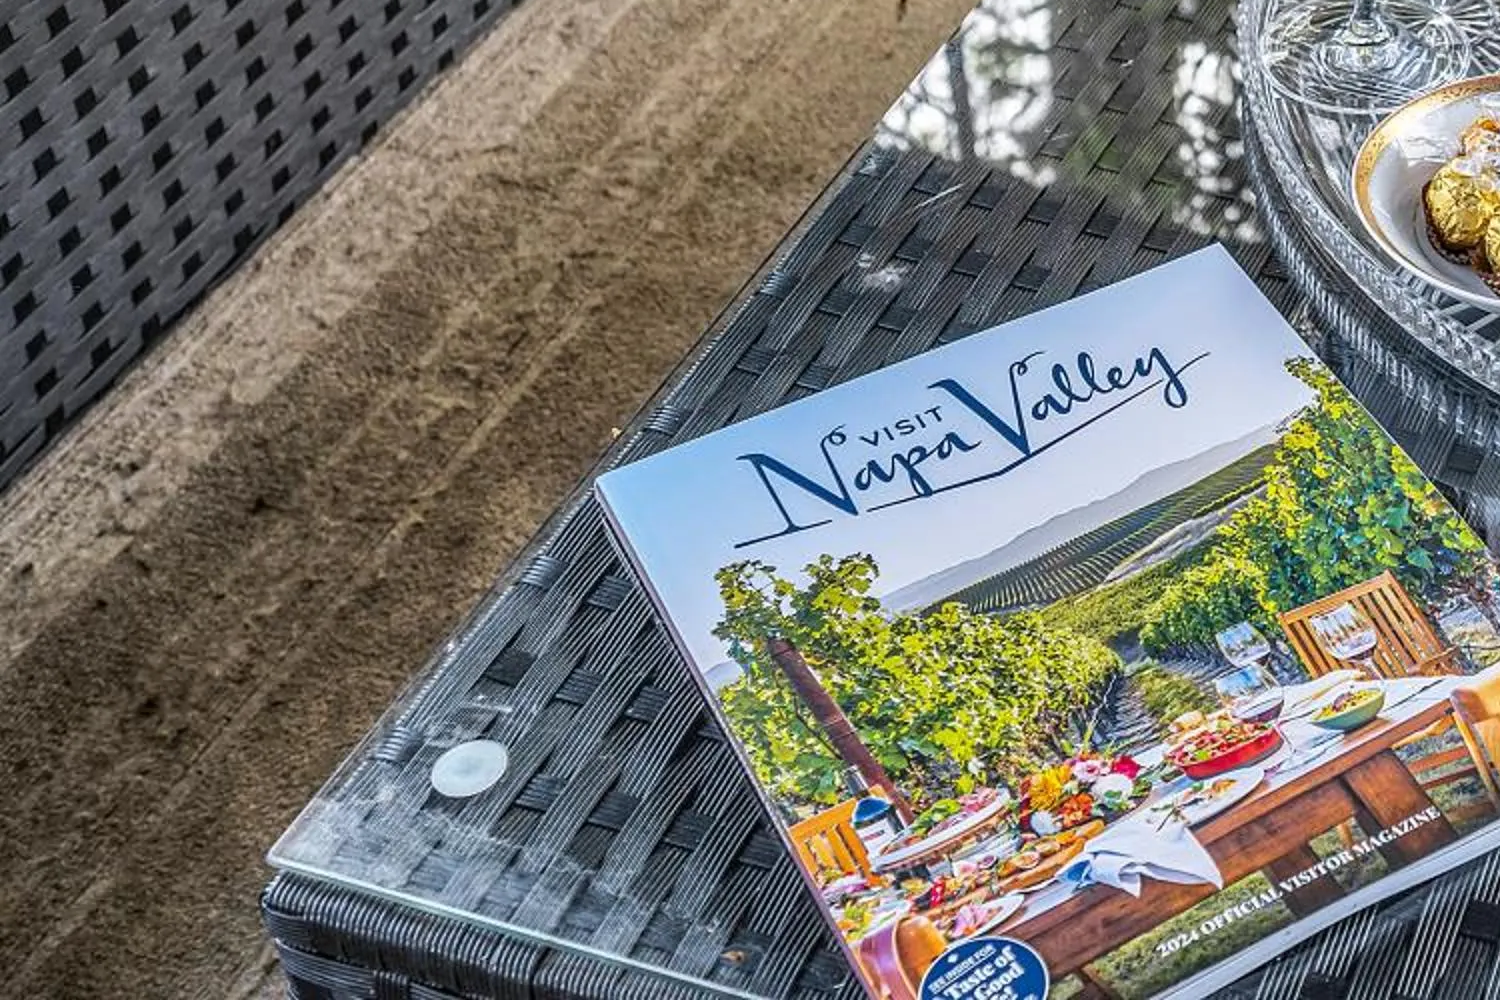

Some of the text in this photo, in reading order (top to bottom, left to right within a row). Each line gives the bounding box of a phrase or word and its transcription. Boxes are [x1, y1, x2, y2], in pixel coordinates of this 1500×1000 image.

[736, 345, 1210, 546] Napa Valley
[859, 405, 943, 447] VISIT
[1155, 805, 1442, 958] 2024 OFFICIAL VISITOR MAGAZINE
[943, 963, 996, 1000] Taste
[994, 945, 1016, 968] of
[974, 961, 1025, 1000] Good
